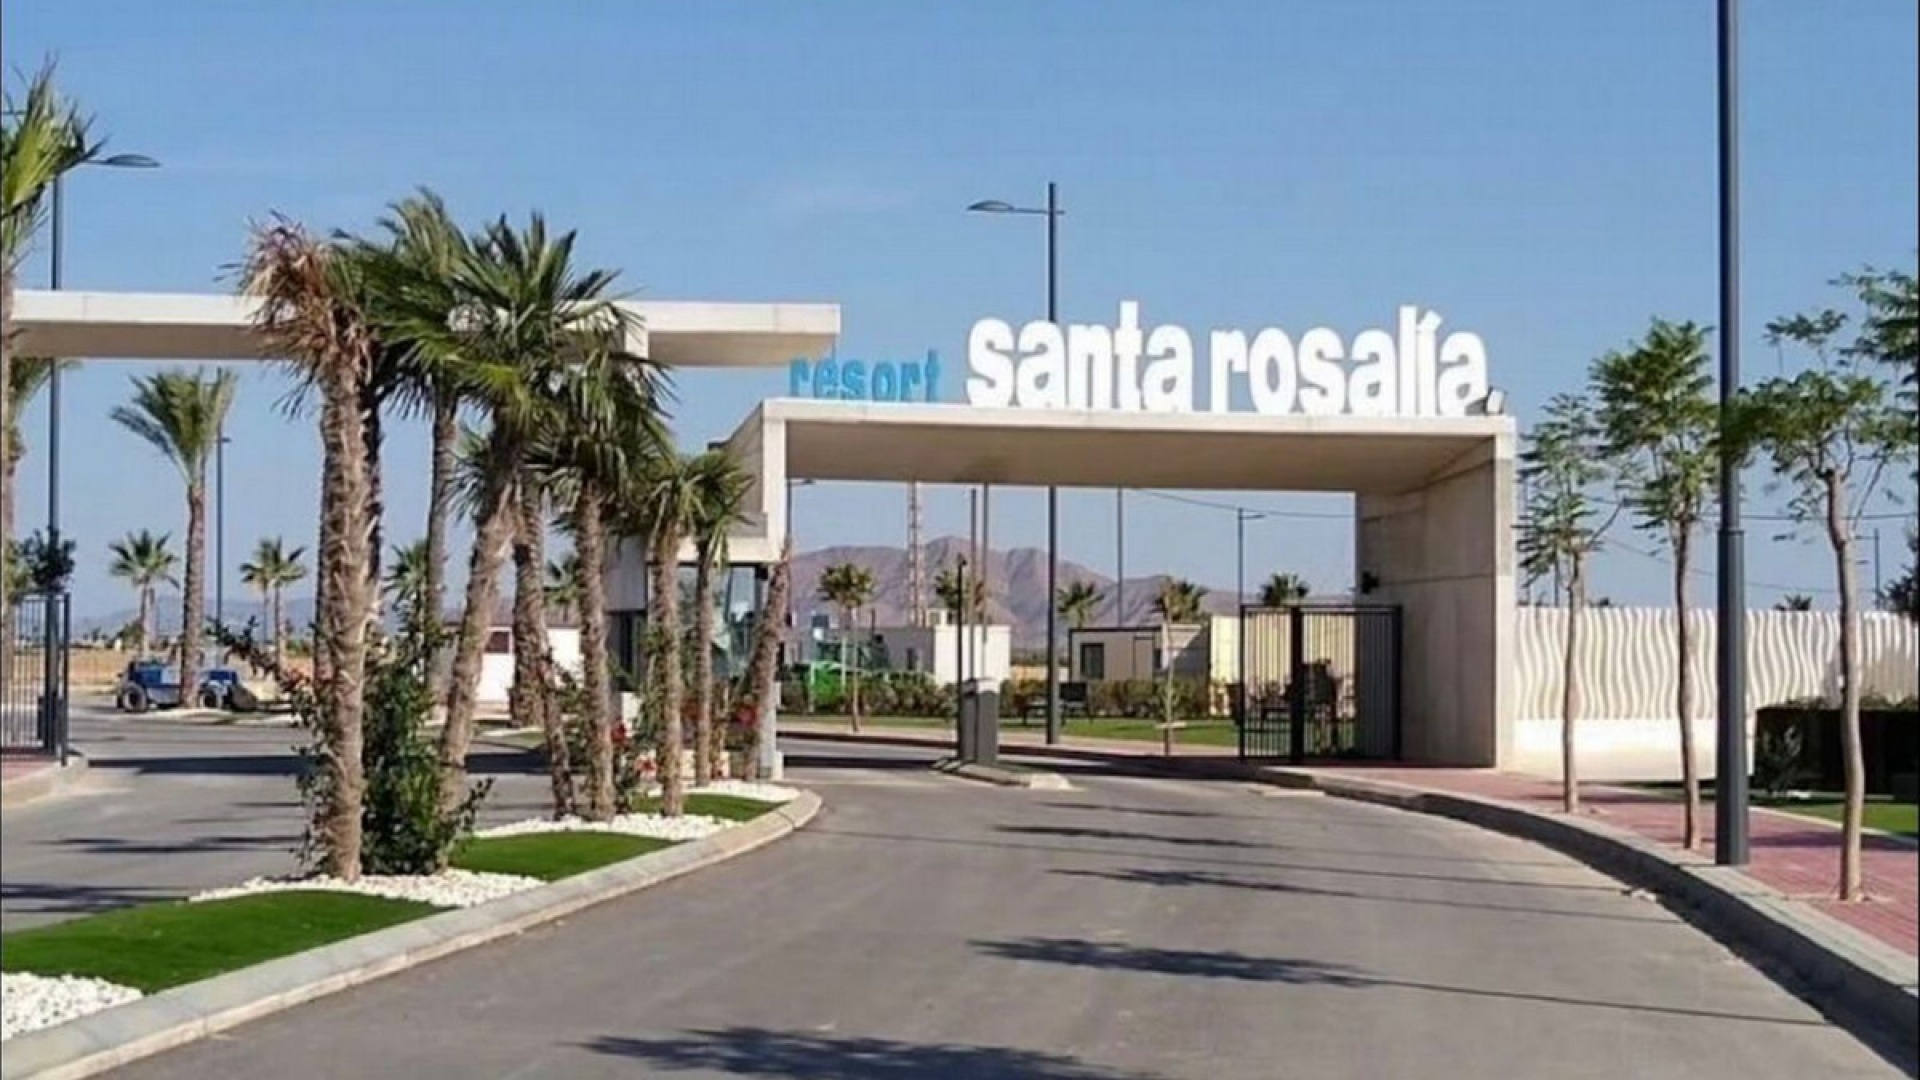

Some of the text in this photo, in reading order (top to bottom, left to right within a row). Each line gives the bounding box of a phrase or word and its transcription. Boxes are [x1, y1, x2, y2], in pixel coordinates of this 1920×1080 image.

[789, 301, 1488, 415] resort santa rosalía
